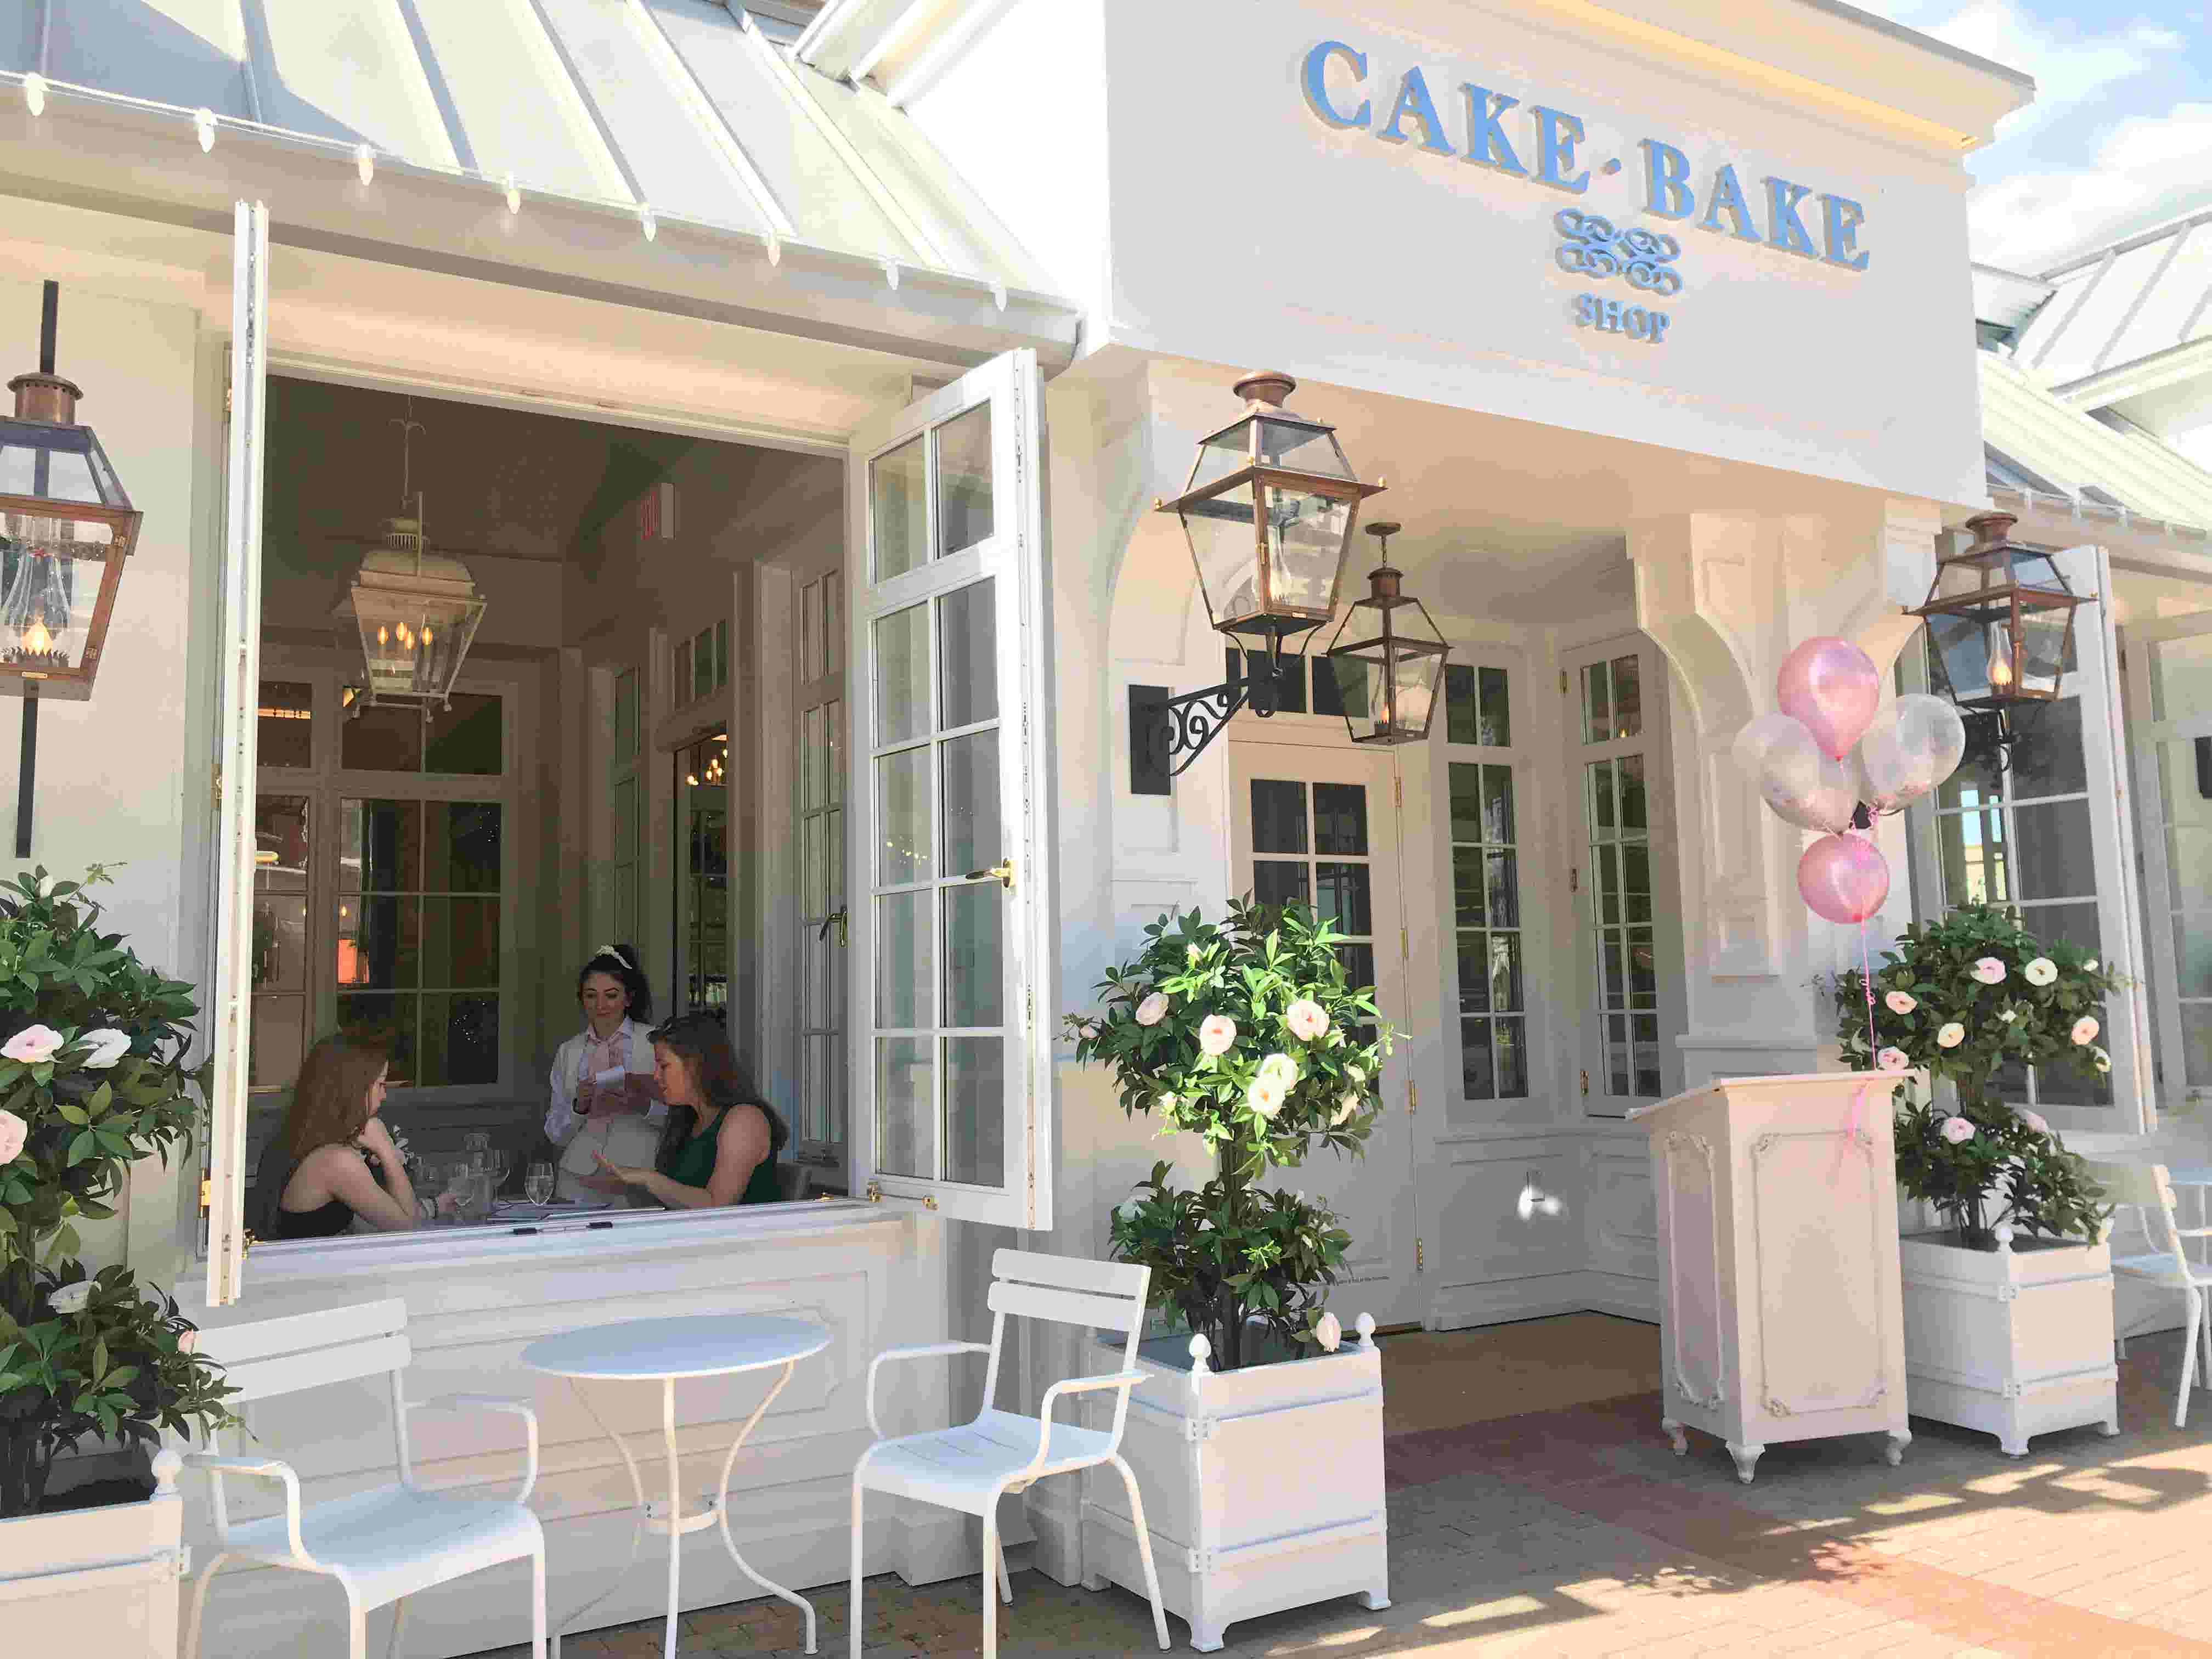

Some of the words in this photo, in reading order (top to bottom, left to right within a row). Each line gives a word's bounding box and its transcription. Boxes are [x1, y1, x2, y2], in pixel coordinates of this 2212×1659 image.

[1301, 40, 1591, 195] CAKE
[1637, 136, 1870, 273] BAKE
[1573, 293, 1671, 345] SHOP
